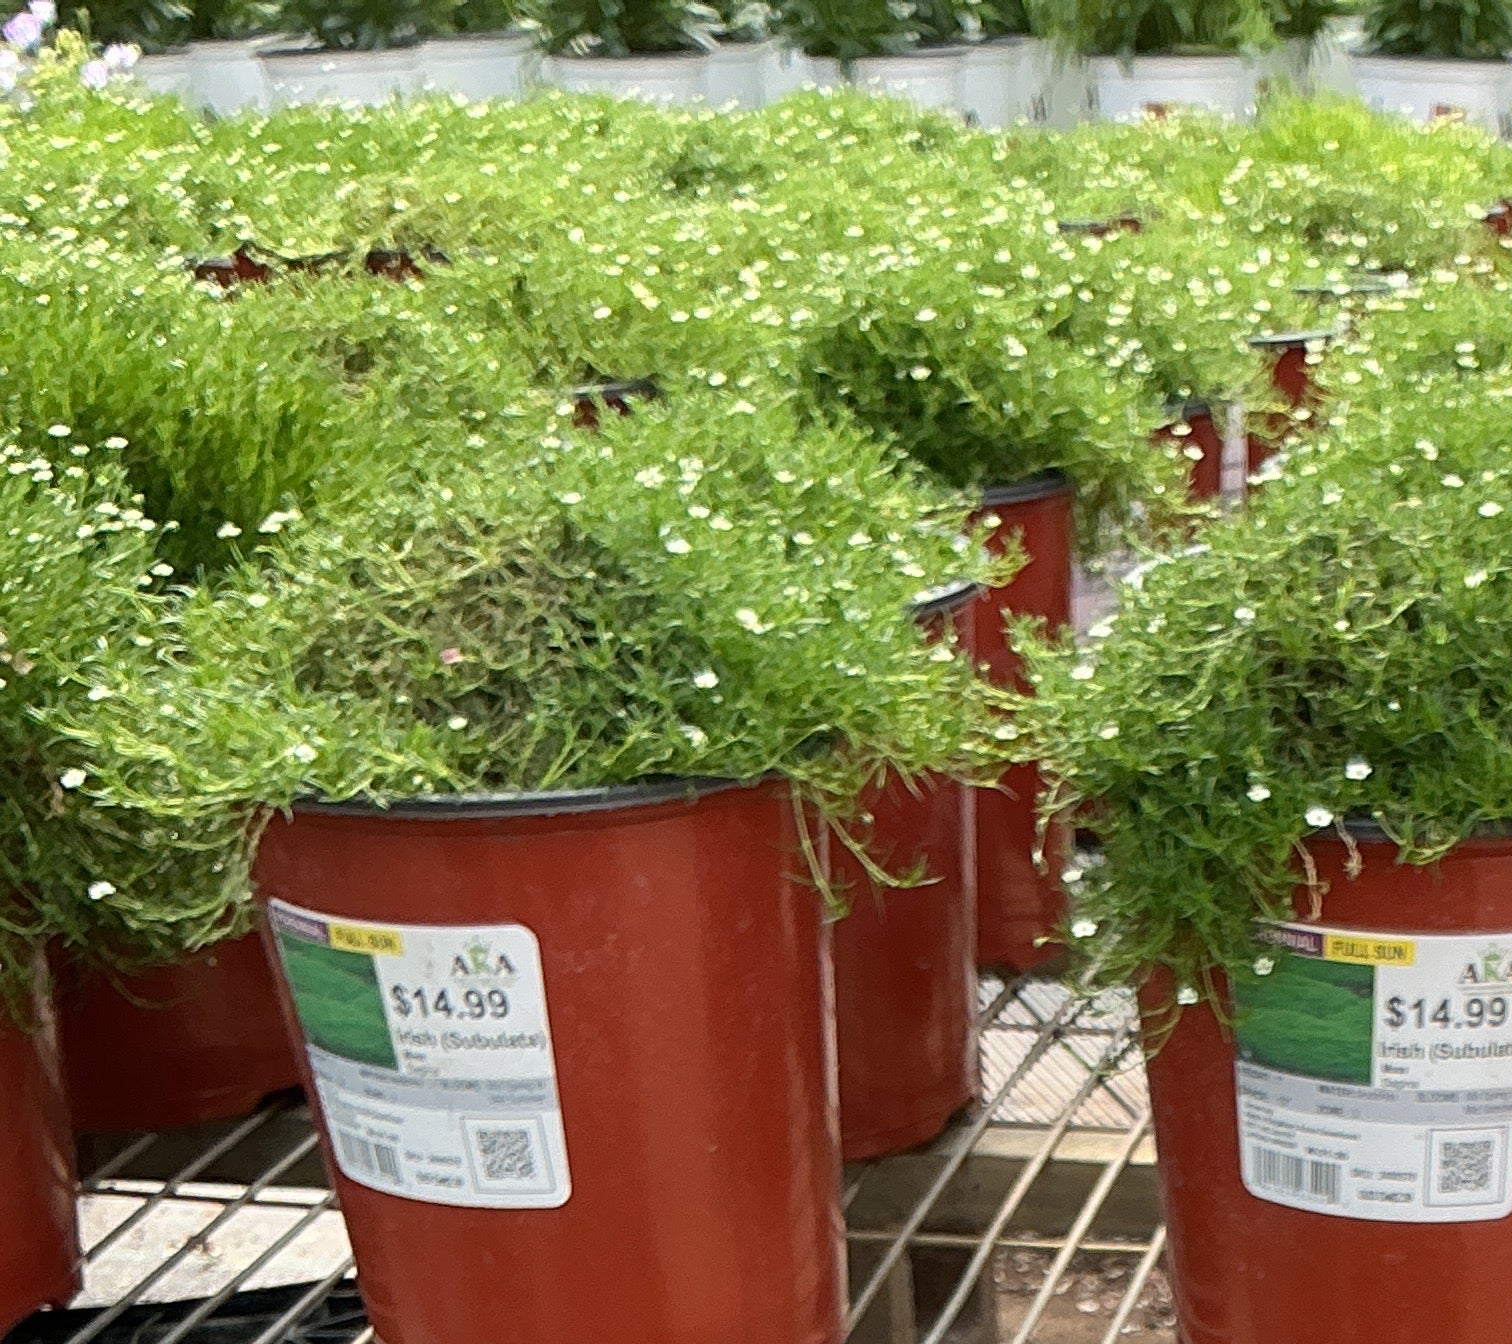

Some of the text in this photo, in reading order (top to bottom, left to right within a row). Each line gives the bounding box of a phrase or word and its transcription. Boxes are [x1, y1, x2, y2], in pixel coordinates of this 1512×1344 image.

[391, 984, 509, 1019] $14.99
[1384, 995, 1509, 1029] $14.99
[1377, 1042, 1426, 1059] Irish
